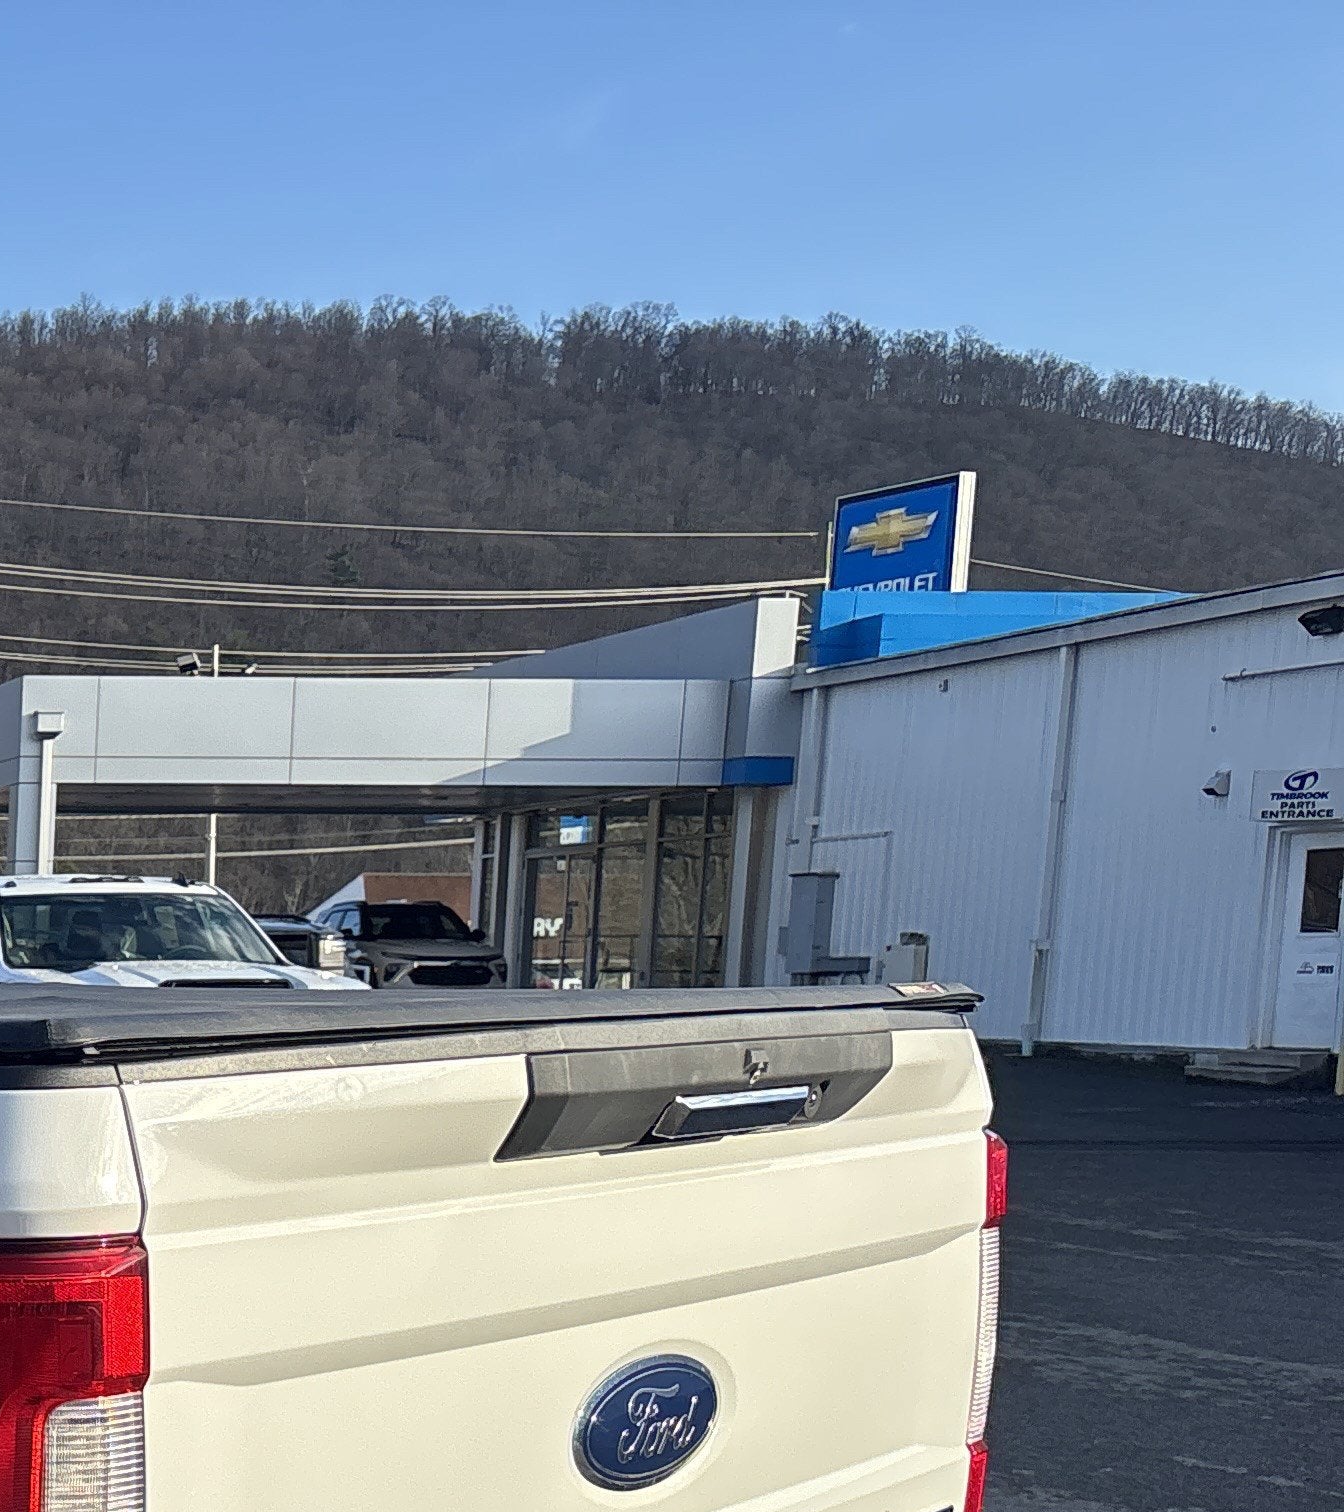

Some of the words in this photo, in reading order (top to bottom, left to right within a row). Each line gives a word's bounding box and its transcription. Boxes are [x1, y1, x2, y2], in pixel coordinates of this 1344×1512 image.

[1270, 791, 1330, 801] TIMBROOK
[1261, 808, 1334, 819] ENTRANCE
[617, 1383, 699, 1465] Ford
